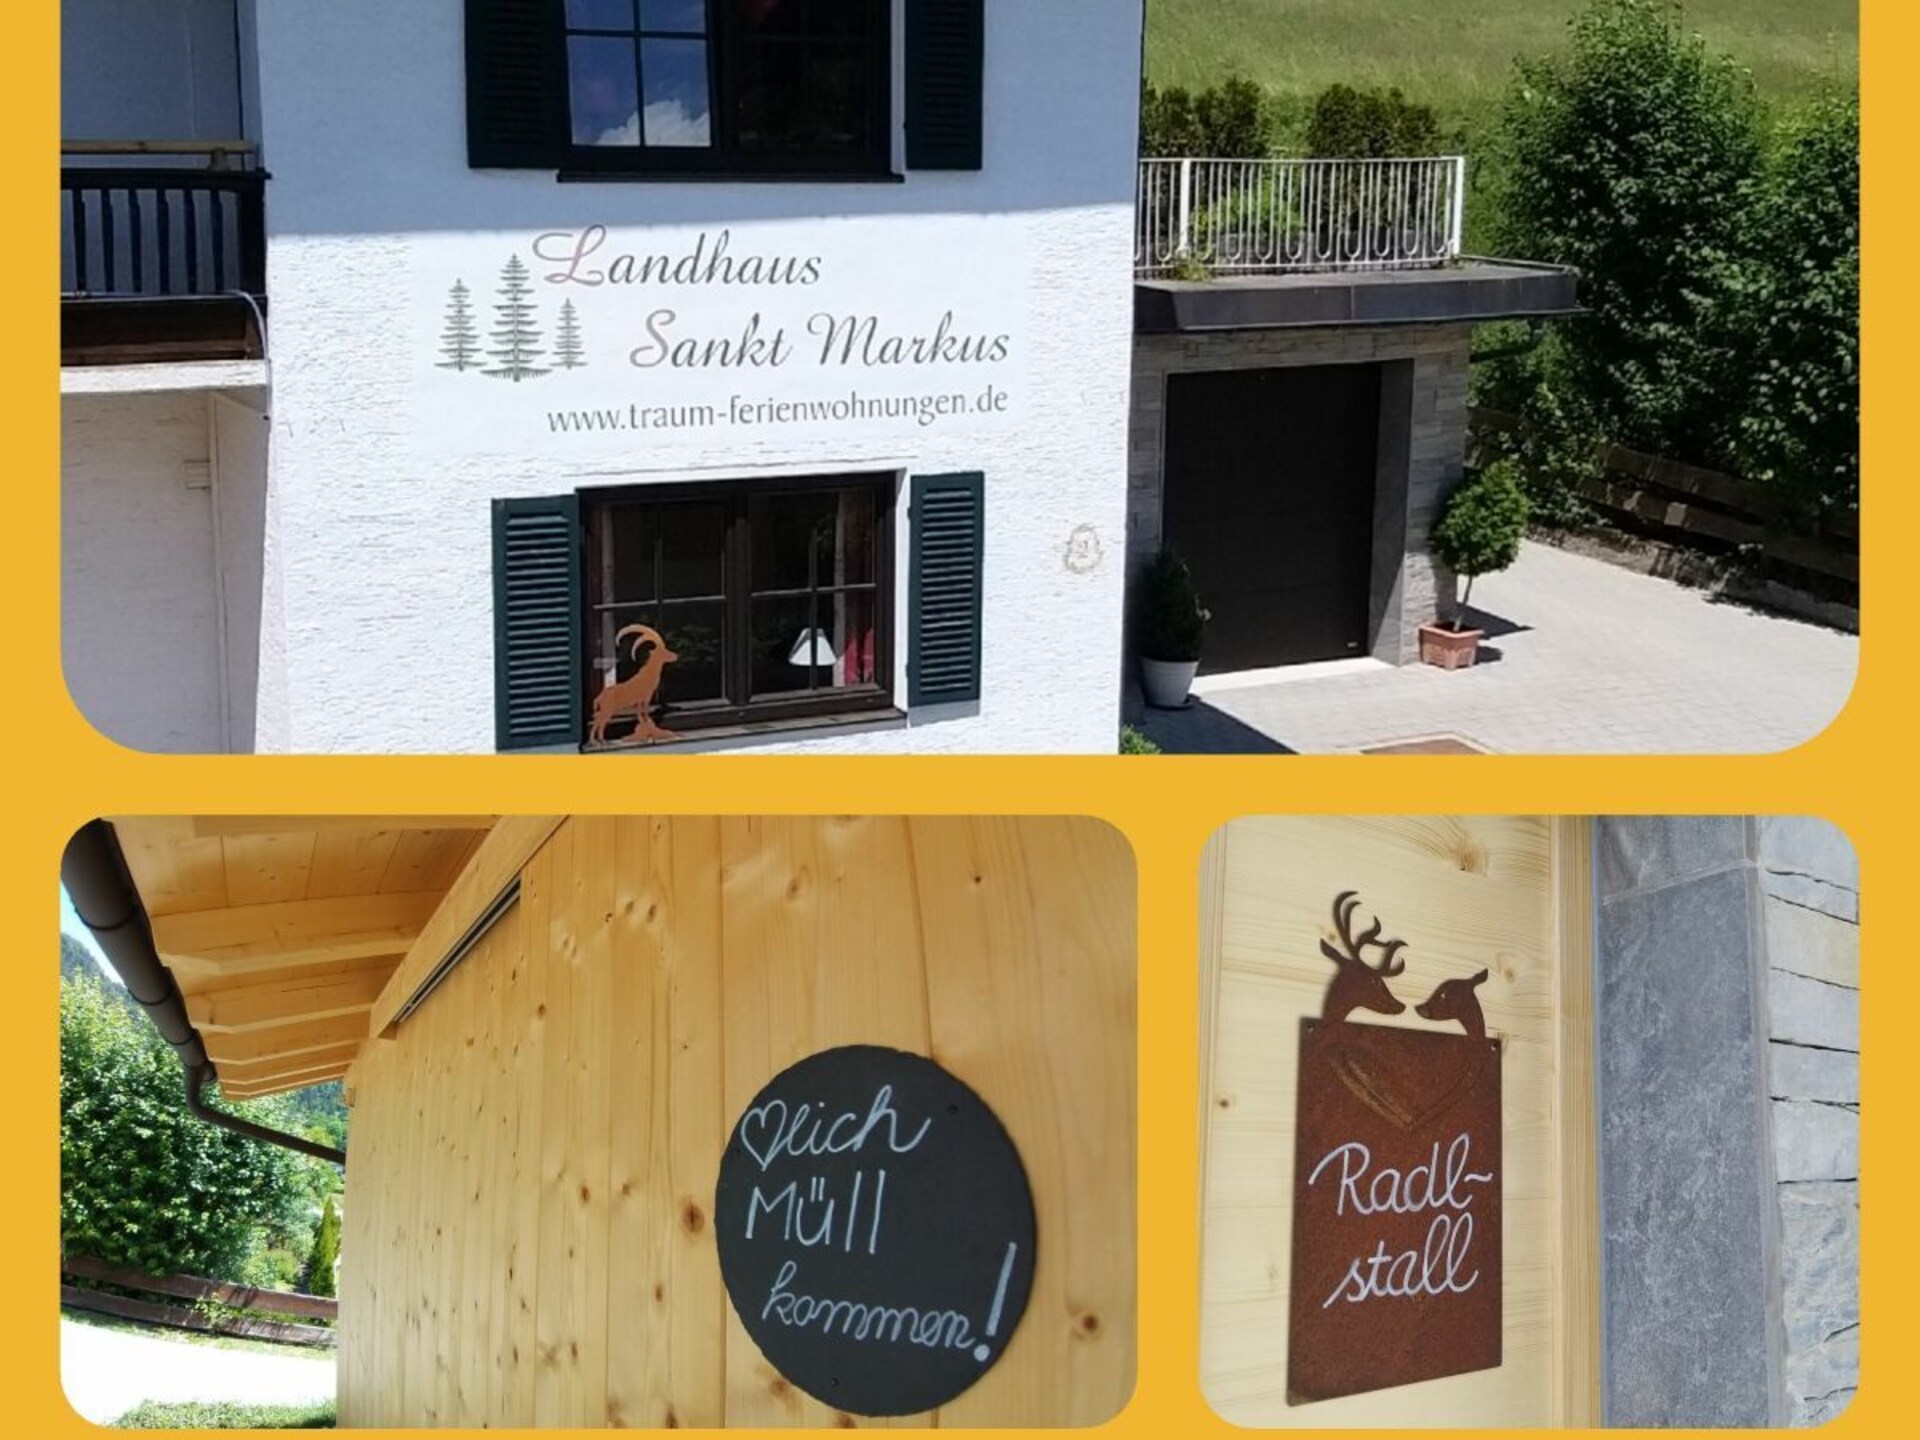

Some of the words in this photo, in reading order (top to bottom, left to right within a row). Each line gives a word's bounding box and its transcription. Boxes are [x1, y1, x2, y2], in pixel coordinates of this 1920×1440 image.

[532, 224, 822, 287] Landhaus
[629, 308, 792, 368] Sankt
[806, 310, 1010, 366] Markus
[547, 384, 1009, 432] www.traum-ferienwohnungen.de
[745, 1169, 886, 1254] Müll
[1322, 1211, 1479, 1309] stall
